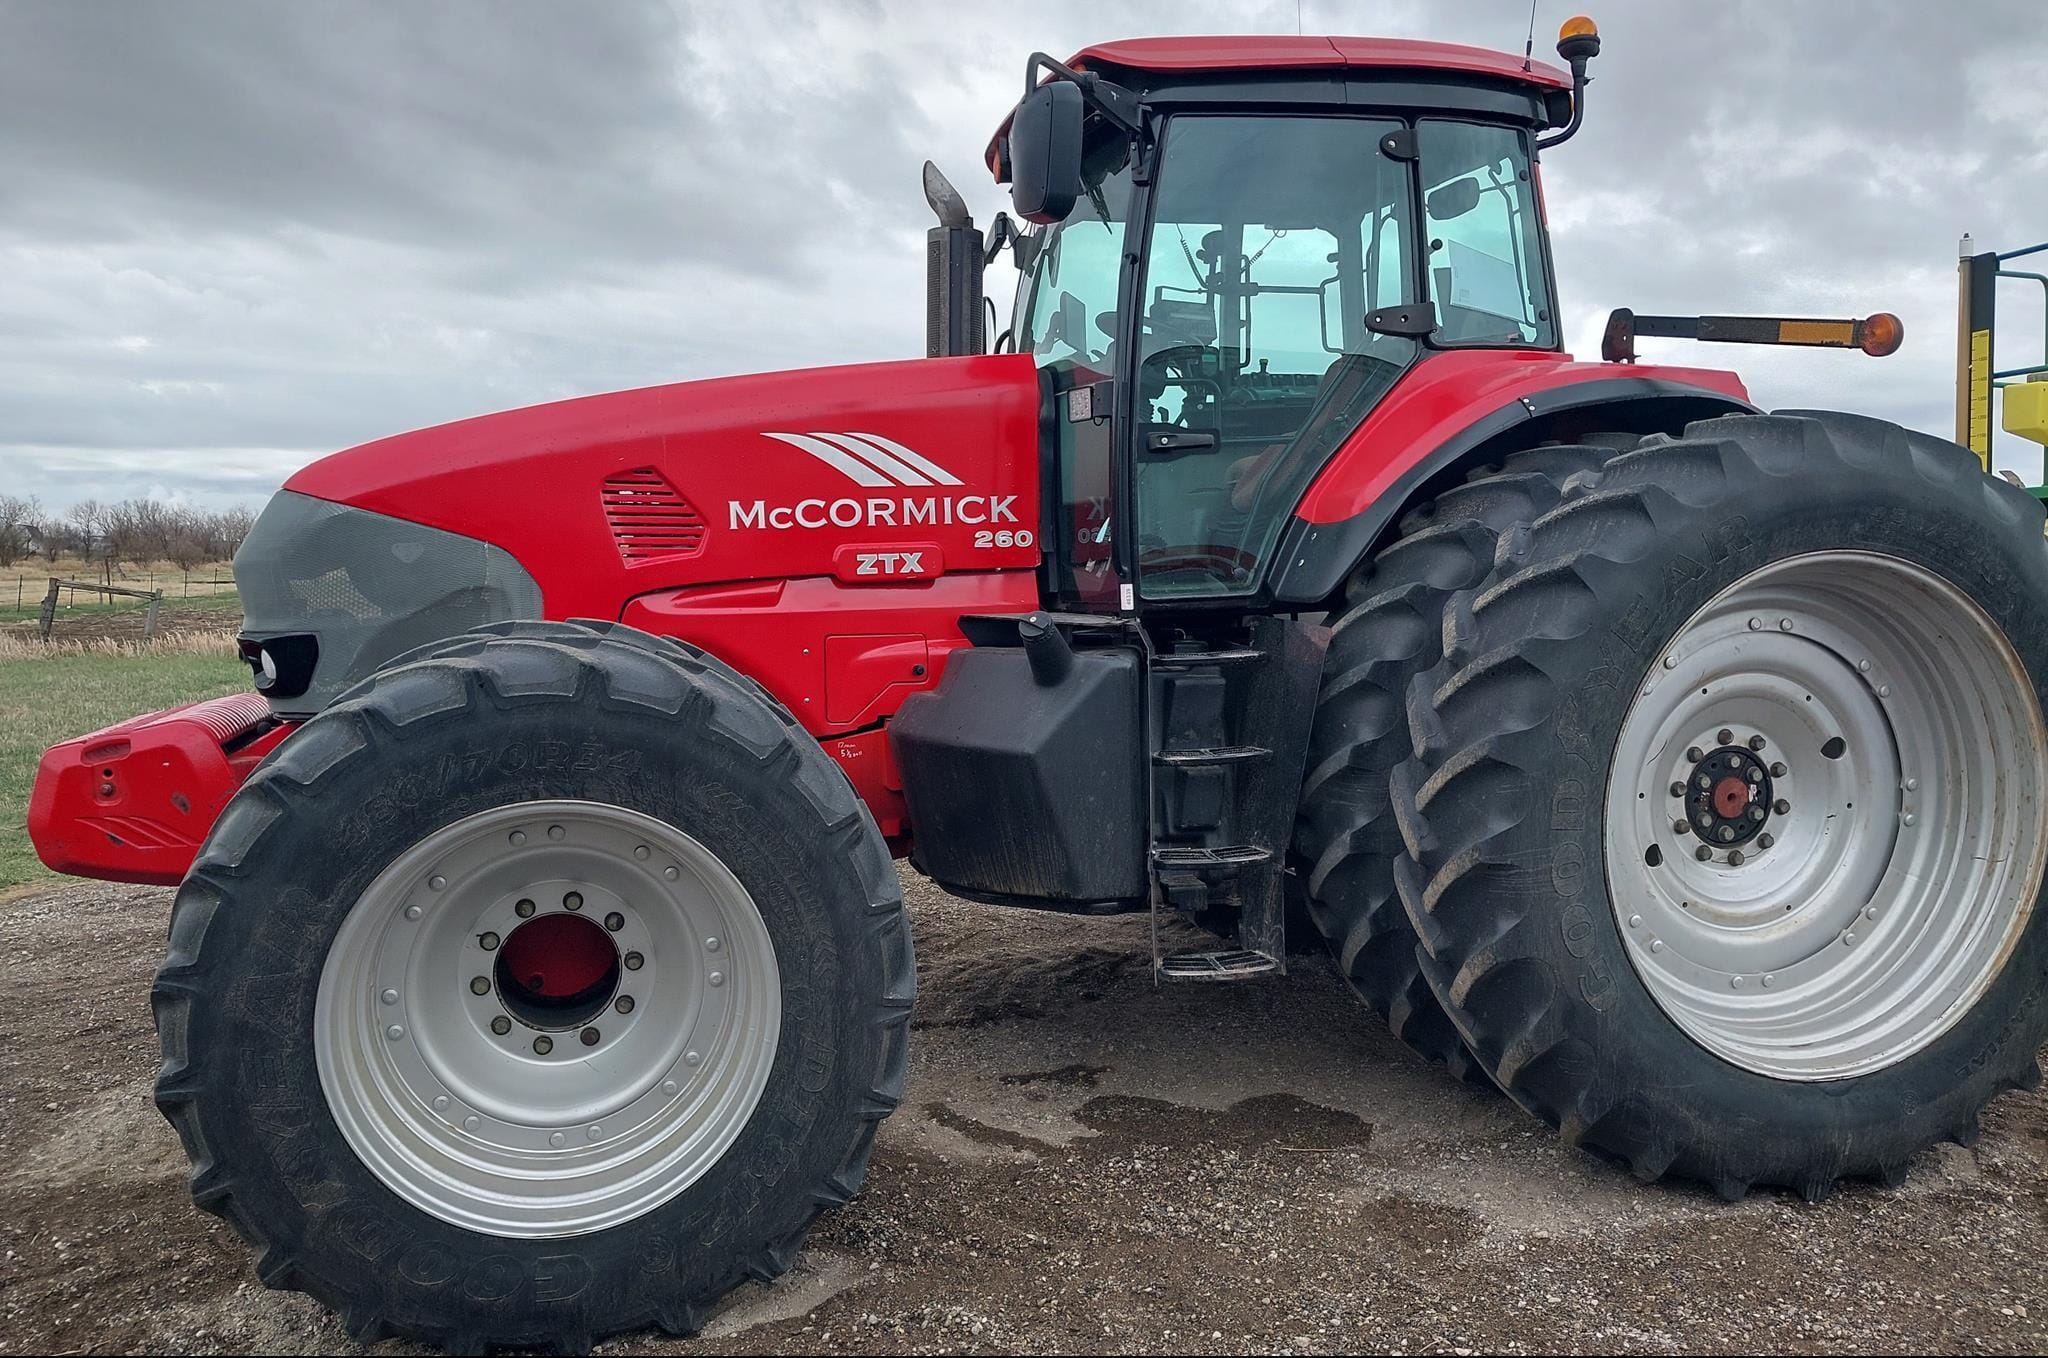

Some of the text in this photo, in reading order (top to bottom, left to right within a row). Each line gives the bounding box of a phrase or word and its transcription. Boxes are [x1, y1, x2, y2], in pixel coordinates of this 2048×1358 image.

[728, 495, 1020, 531] McCORMICK
[973, 529, 1034, 548] 260
[855, 552, 925, 575] ZTX
